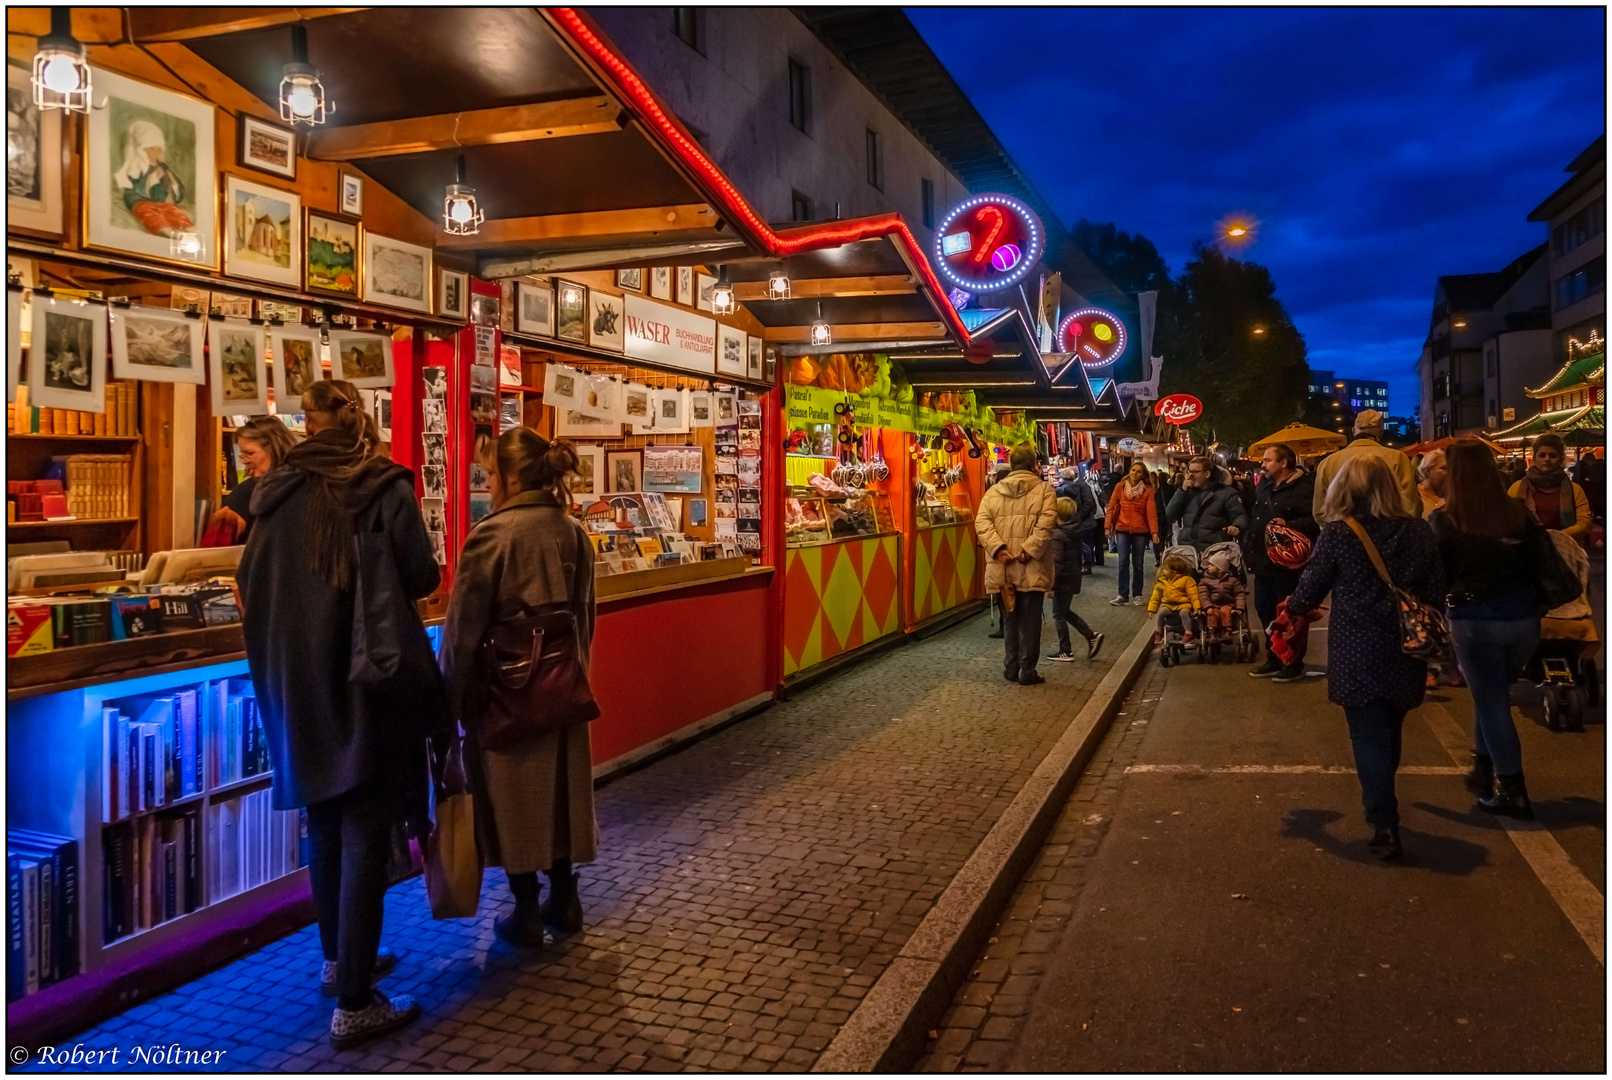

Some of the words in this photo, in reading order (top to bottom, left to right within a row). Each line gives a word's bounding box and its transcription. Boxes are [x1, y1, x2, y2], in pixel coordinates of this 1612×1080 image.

[627, 315, 670, 345] WASER
[675, 329, 713, 346] BUCHHANDLUNG
[684, 341, 713, 355] ANTIQUARIAT
[790, 386, 811, 402] Pascal's
[1160, 399, 1197, 419] Eiche
[165, 601, 188, 615] Hill
[66, 866, 74, 904] LEBEN
[11, 874, 21, 950] WELTATLAS
